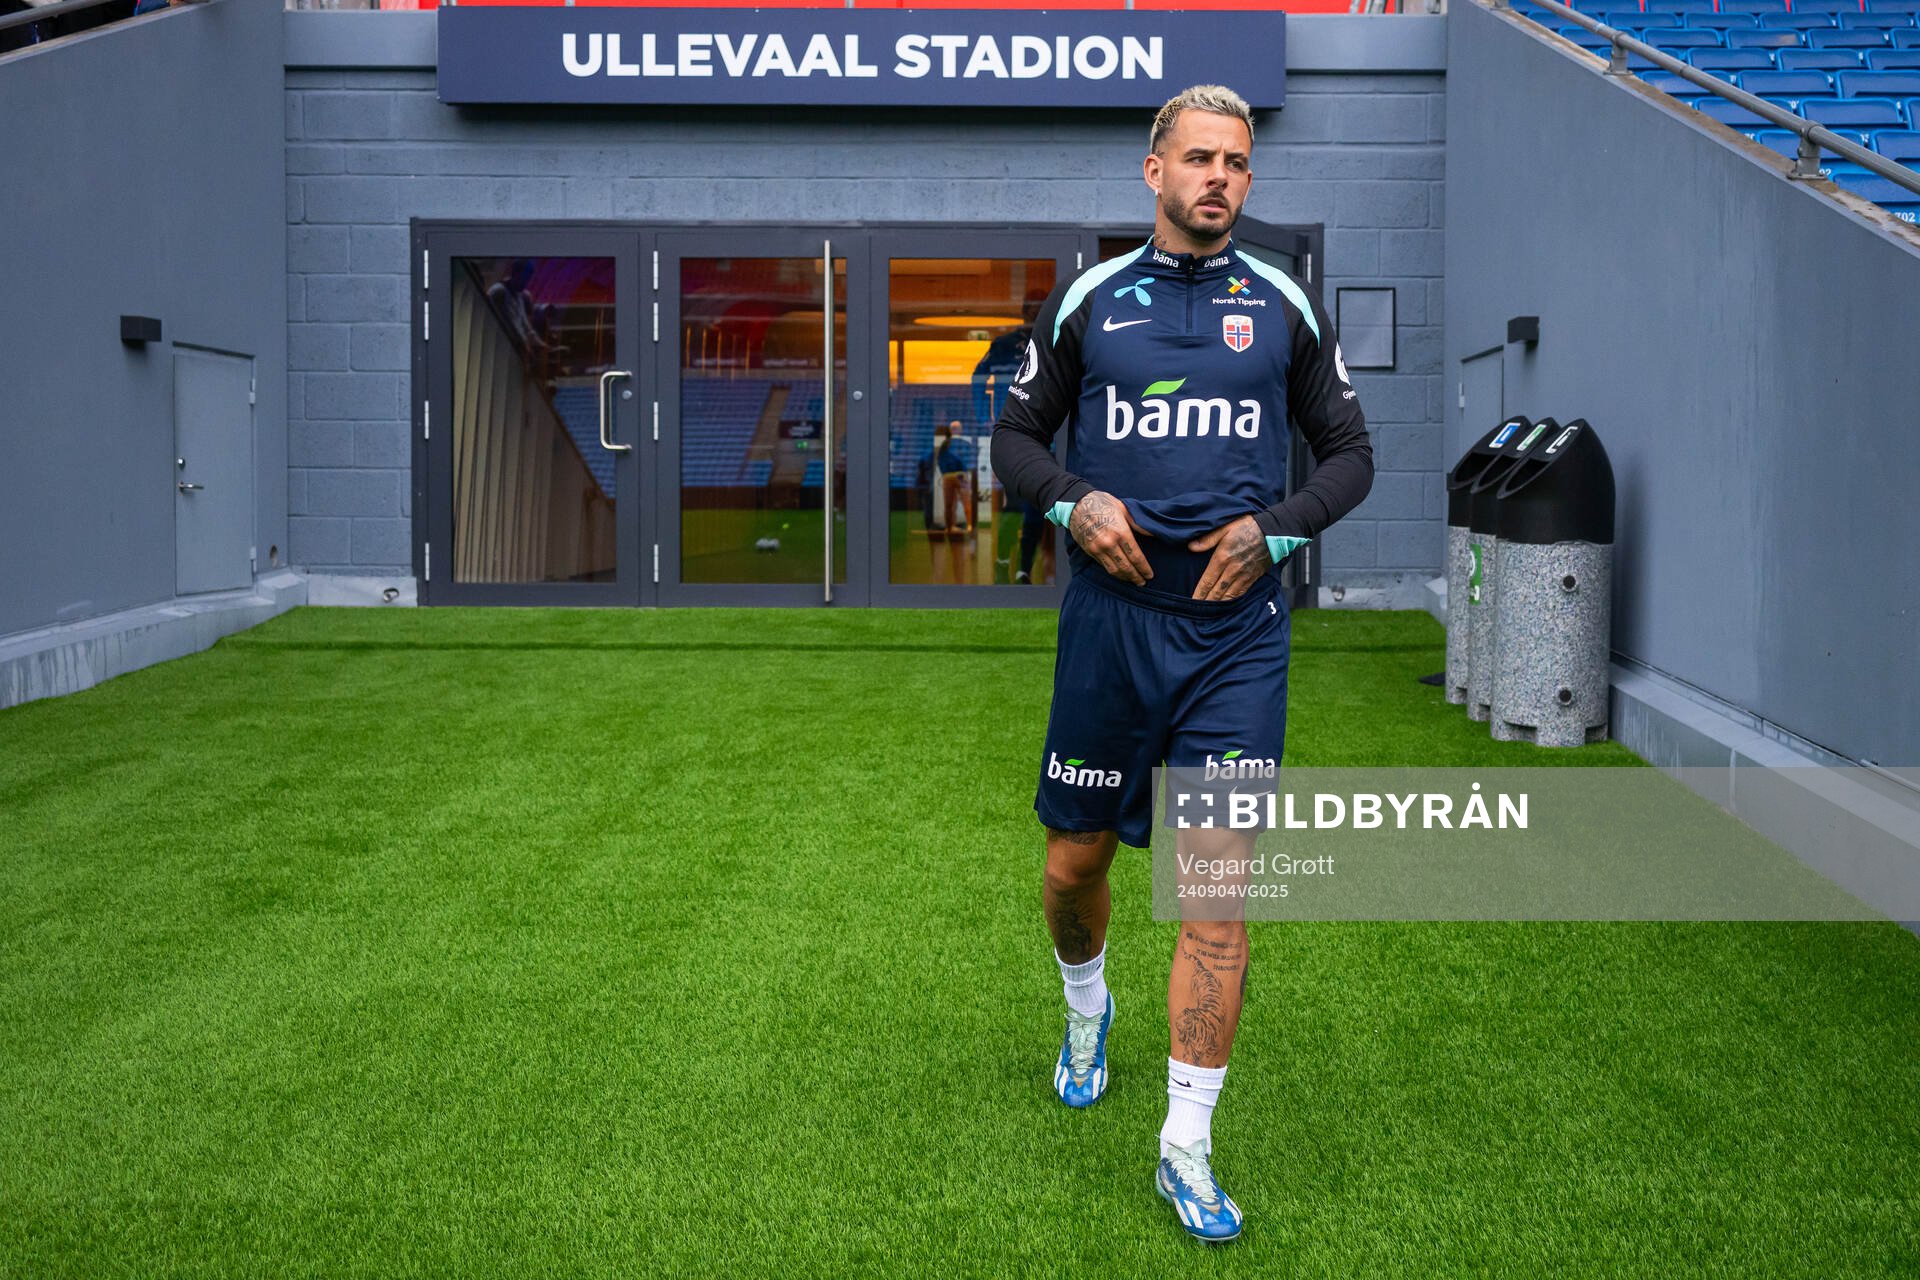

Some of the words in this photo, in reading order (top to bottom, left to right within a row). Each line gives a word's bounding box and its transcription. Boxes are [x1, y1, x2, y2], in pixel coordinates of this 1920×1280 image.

[562, 33, 879, 78] ULLEVAAL
[893, 34, 1164, 80] STADION
[1152, 248, 1180, 268] bama
[1203, 256, 1230, 268] bama
[1236, 298, 1267, 307] Tipping
[1106, 384, 1262, 441] bama
[1267, 601, 1277, 615] 3
[1047, 751, 1123, 788] bama
[1204, 754, 1276, 782] bama
